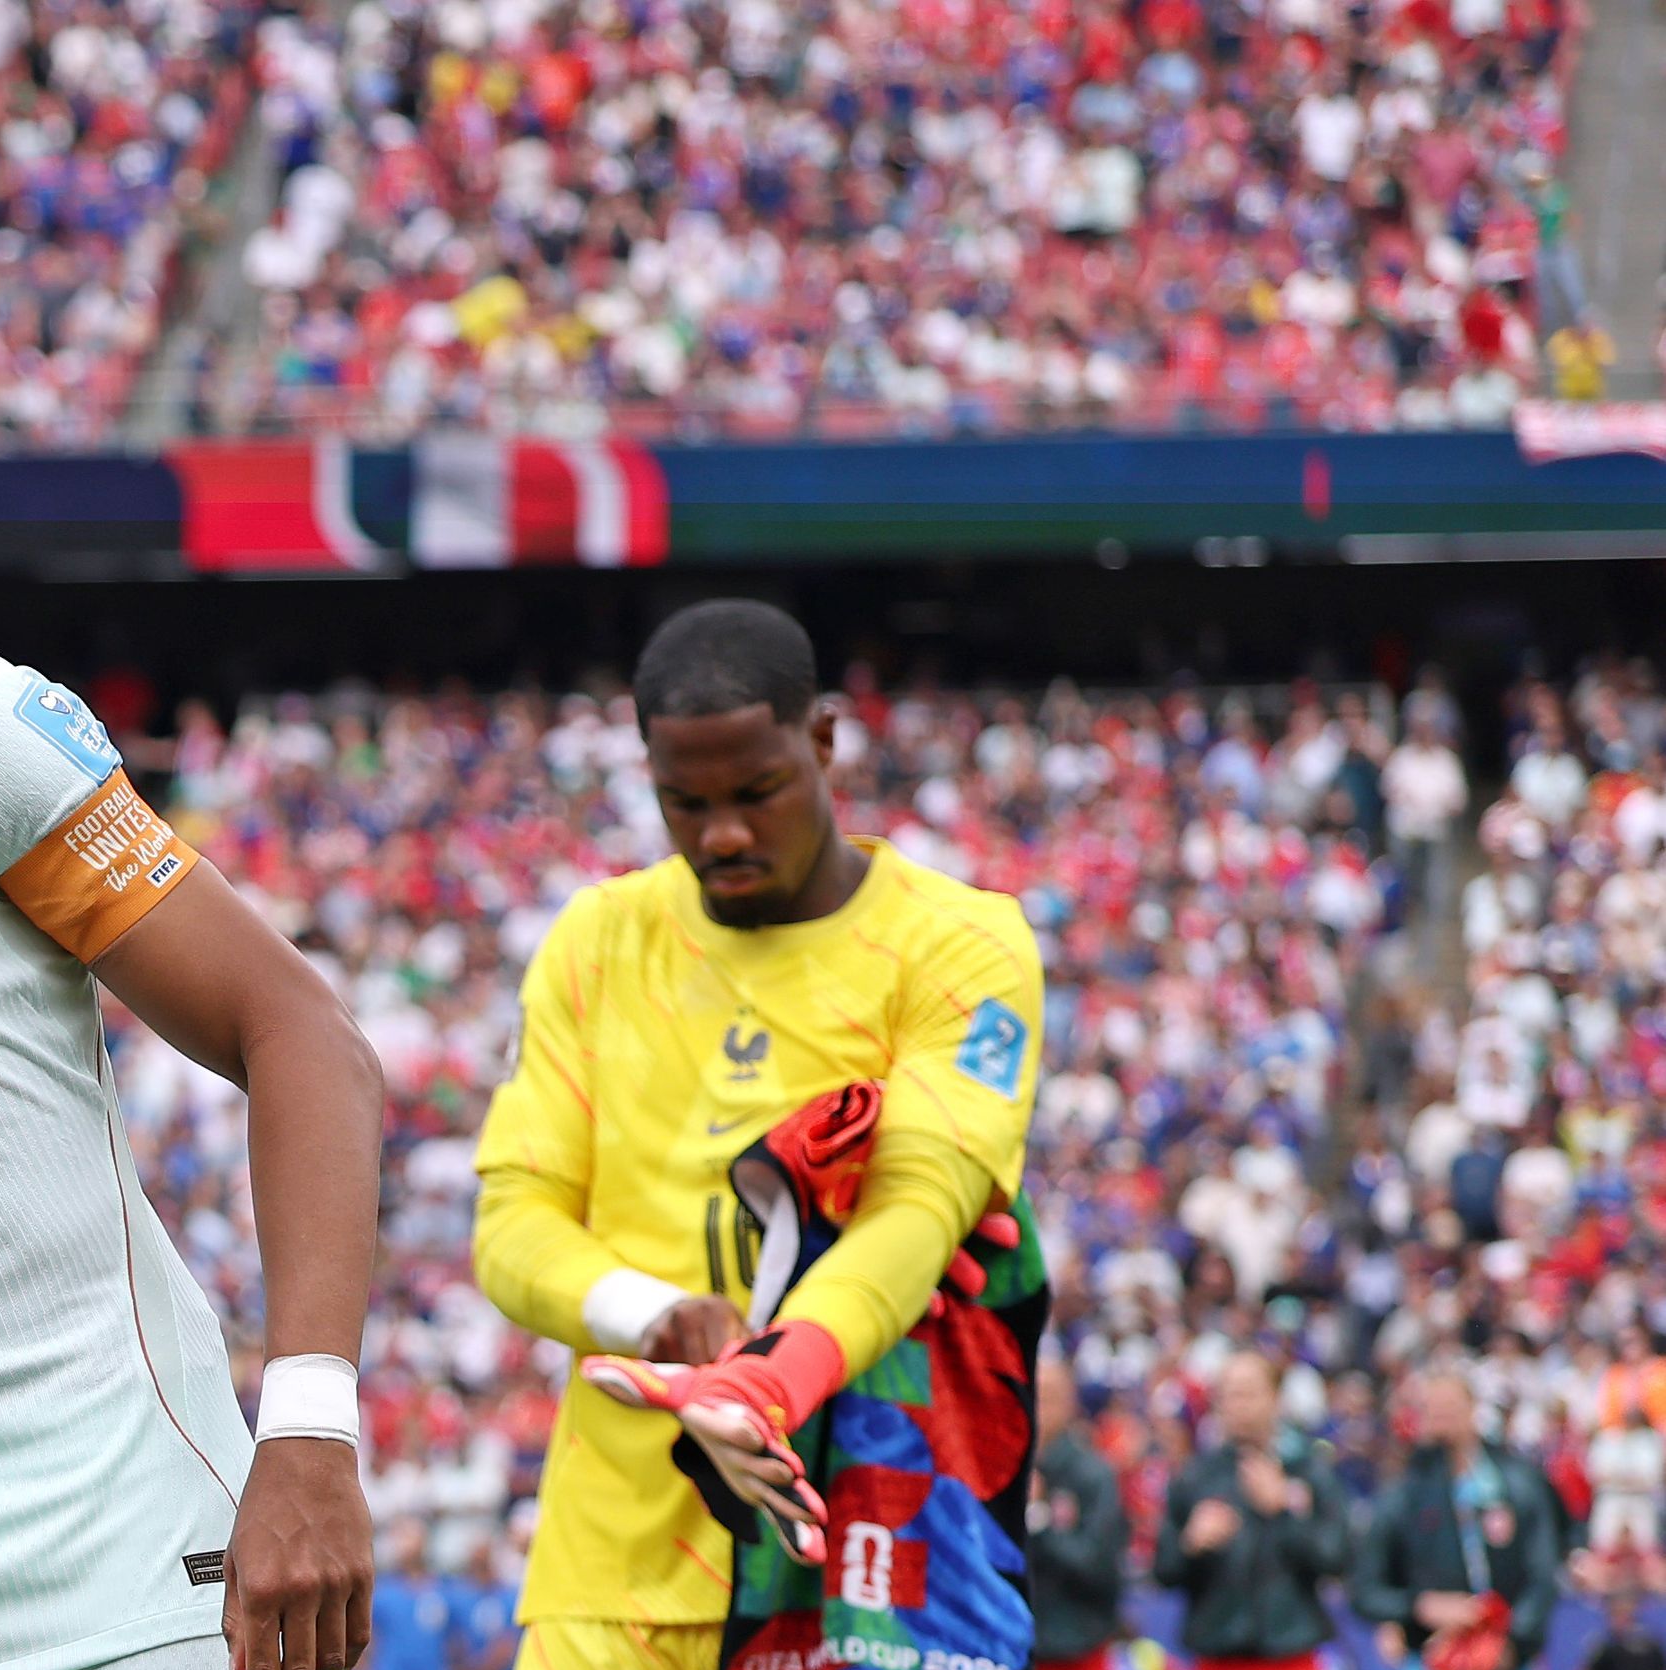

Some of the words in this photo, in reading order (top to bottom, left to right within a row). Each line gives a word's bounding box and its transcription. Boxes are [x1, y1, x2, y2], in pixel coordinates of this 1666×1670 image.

[63, 781, 135, 852] FOOTBALL
[78, 800, 152, 871] UNITES
[103, 862, 139, 892] the
[151, 858, 179, 883] FIFA
